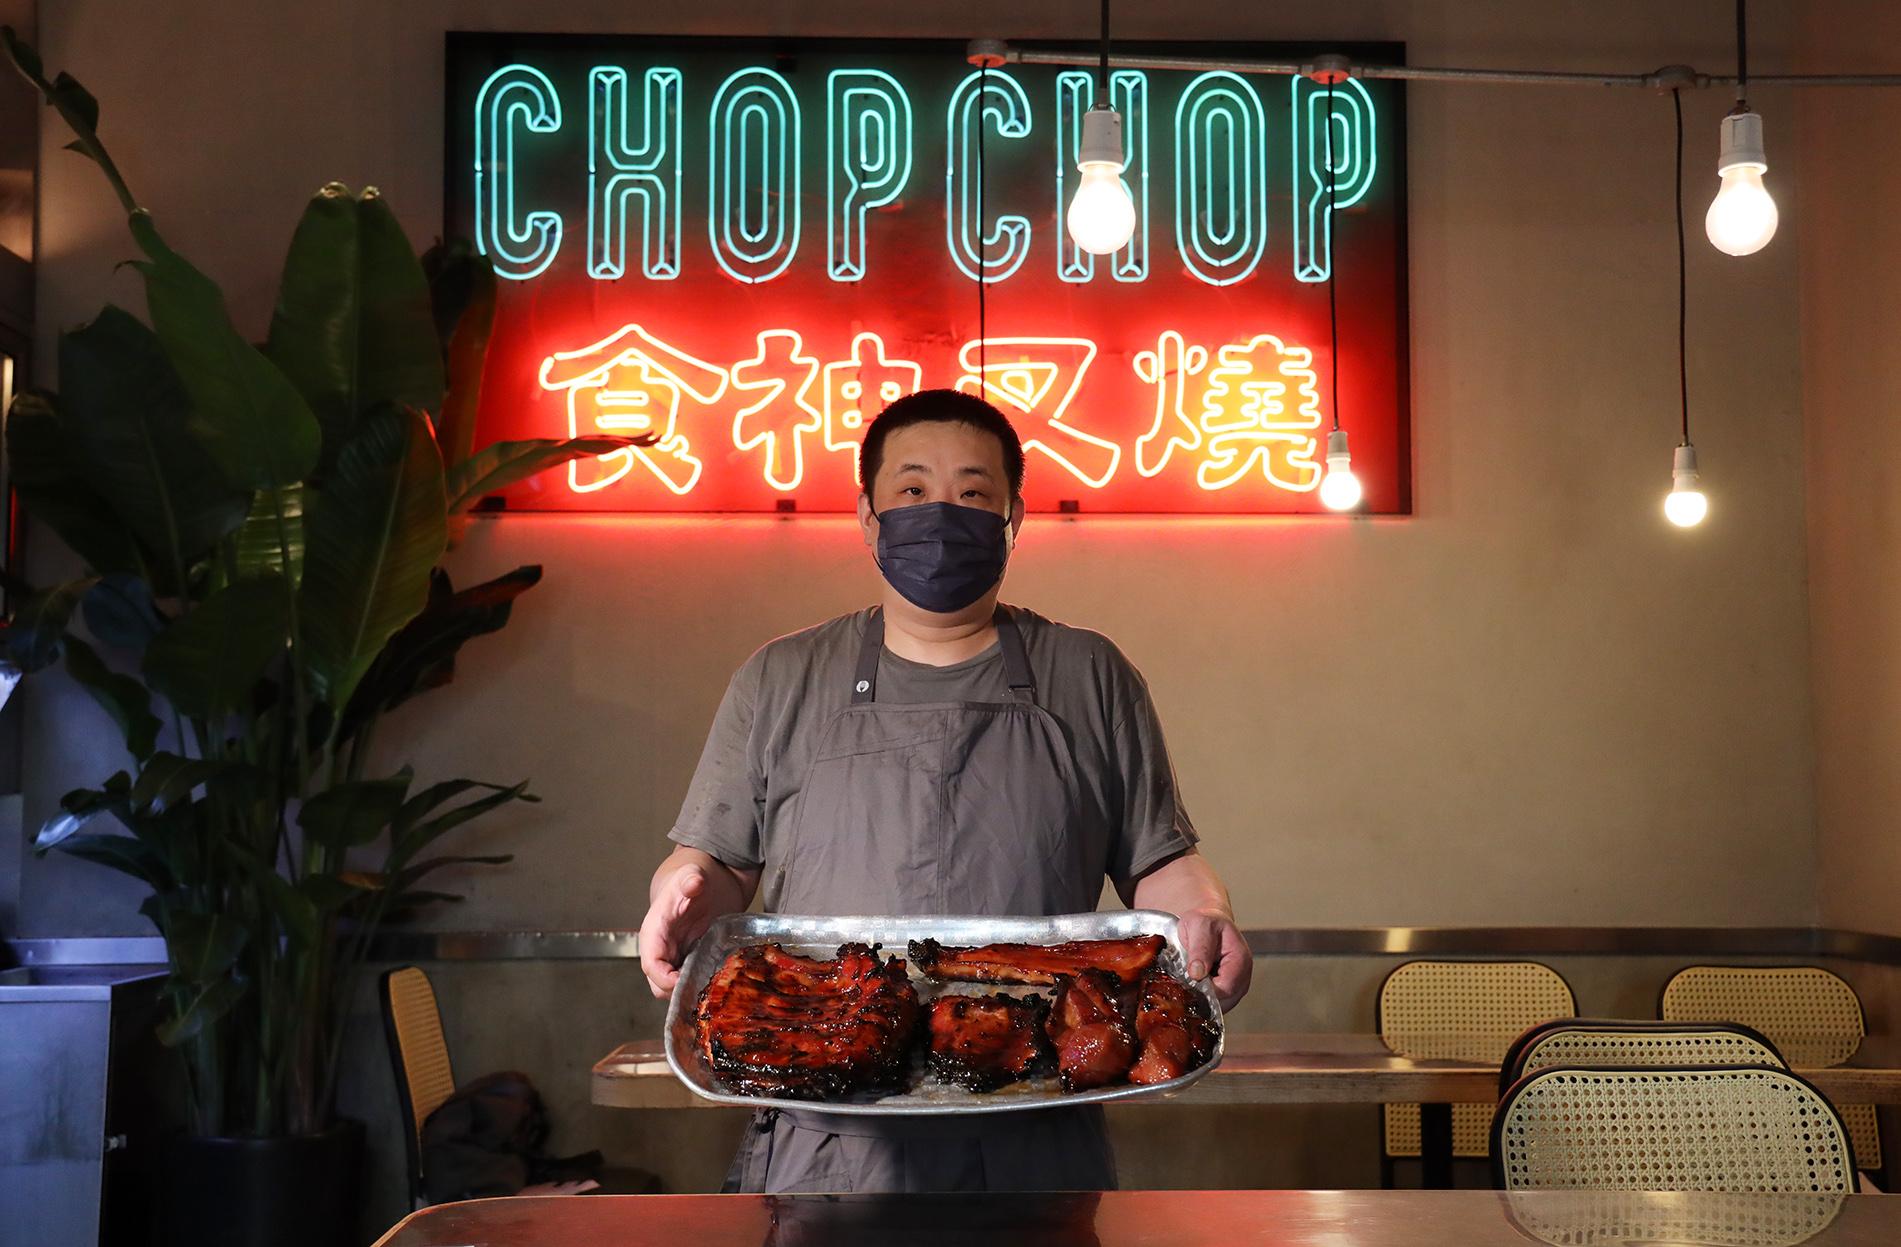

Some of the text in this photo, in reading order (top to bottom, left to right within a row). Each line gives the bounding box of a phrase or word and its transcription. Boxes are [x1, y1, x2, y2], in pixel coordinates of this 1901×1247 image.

[474, 64, 1376, 286] CHOP CHOP
[538, 323, 1322, 495] 食神叉燒
